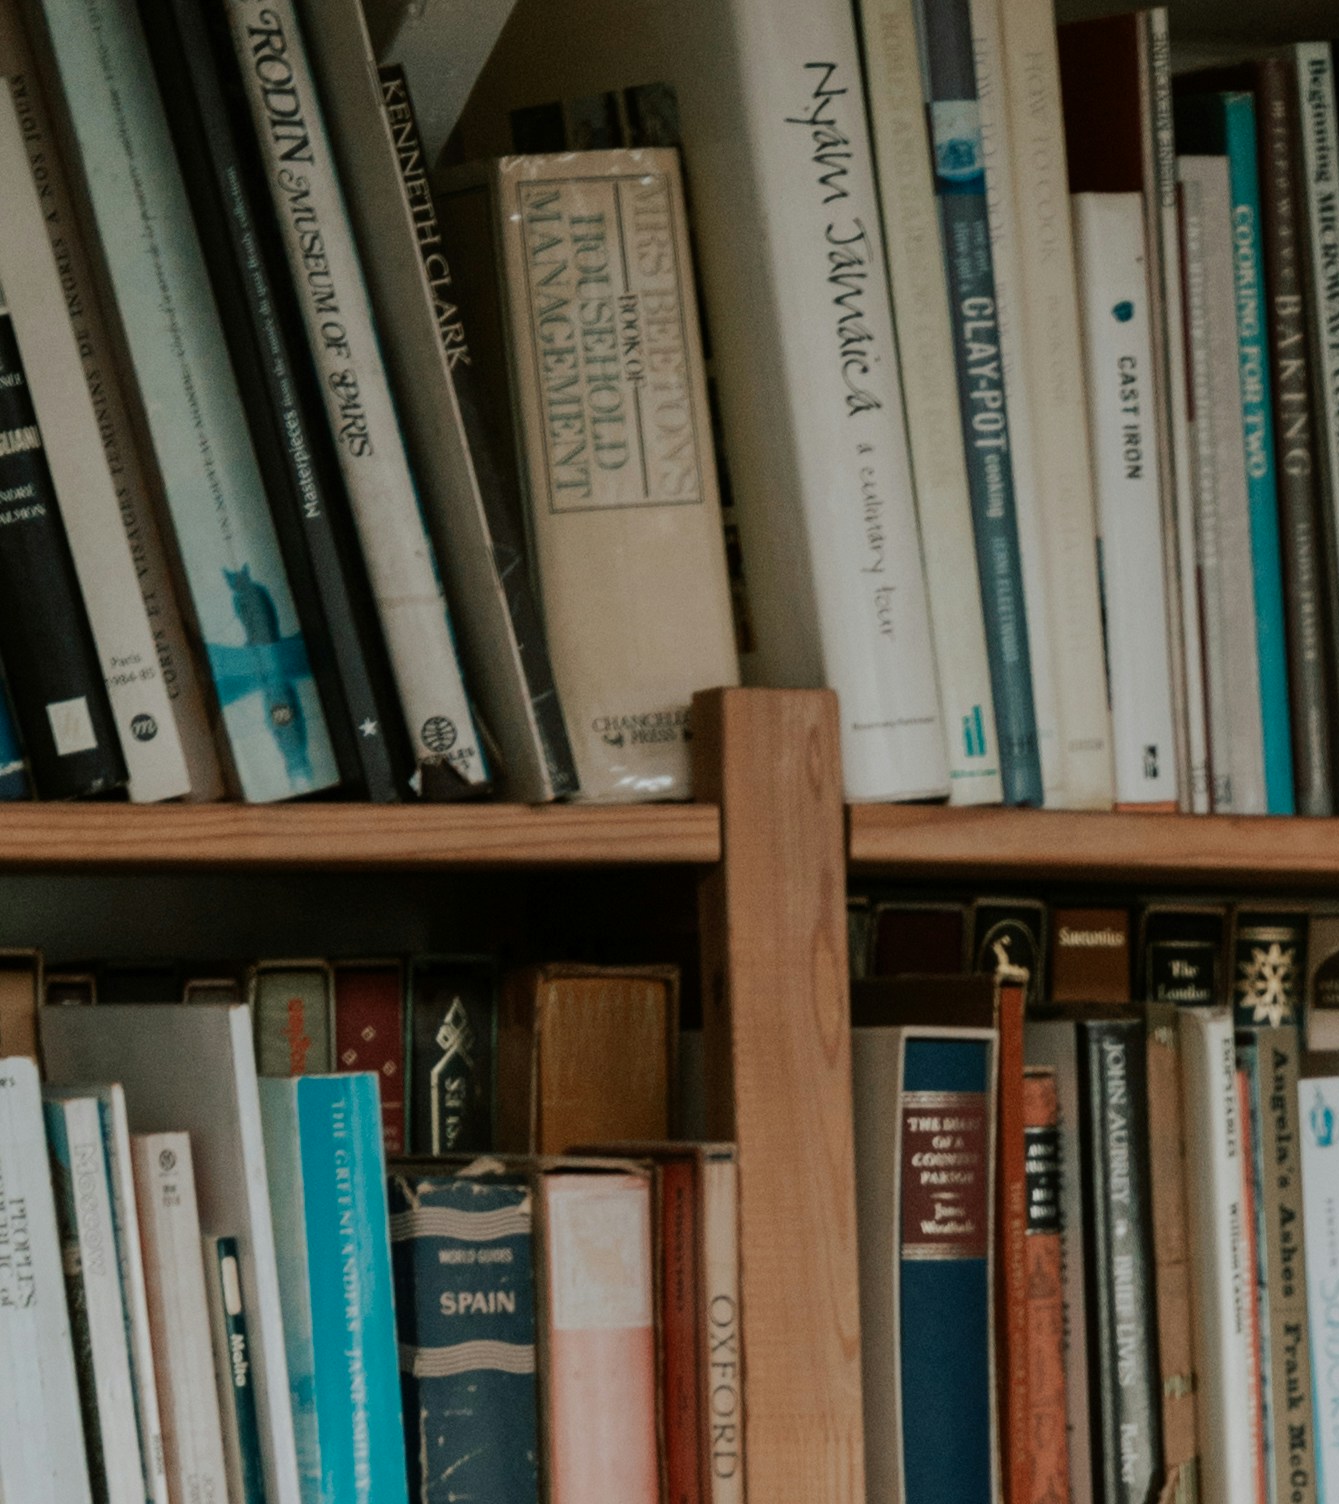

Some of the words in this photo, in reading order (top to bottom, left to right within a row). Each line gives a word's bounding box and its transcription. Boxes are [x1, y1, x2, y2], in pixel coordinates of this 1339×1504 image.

[247, 8, 314, 166] RODIN
[785, 59, 854, 206] Nyam
[279, 168, 340, 311] MUSEUM
[380, 79, 443, 245] KENNETH
[421, 252, 472, 369] CLARK
[1233, 206, 1260, 337] COOKING
[320, 322, 351, 362] OF
[524, 189, 592, 498] MANAGEMENT
[569, 212, 629, 471] HOUSEHOLD
[618, 294, 642, 354] BOOK
[822, 216, 884, 420] Jamaica
[329, 370, 374, 458] PARIS
[961, 297, 1008, 451] CLAY-POT
[1117, 356, 1143, 418] CAST
[1240, 344, 1264, 403] FOR
[1274, 295, 1312, 477] BAKING
[283, 409, 322, 520] Masterpieces
[1123, 424, 1147, 481] IRON
[1246, 409, 1268, 477] TWO
[857, 464, 894, 578] culinary
[873, 582, 898, 642] tour
[1103, 1043, 1128, 1104] JOHN
[1271, 1047, 1297, 1190] Angela's
[1107, 1111, 1132, 1204] AUBREY
[72, 1143, 107, 1277] Moscow
[1277, 1203, 1299, 1300] Ashes
[440, 1289, 516, 1314] SPAIN
[1113, 1254, 1135, 1318] BRIEF
[709, 1294, 738, 1480] OXFORD
[1116, 1322, 1138, 1386] LIVES
[1282, 1321, 1305, 1412] Frank
